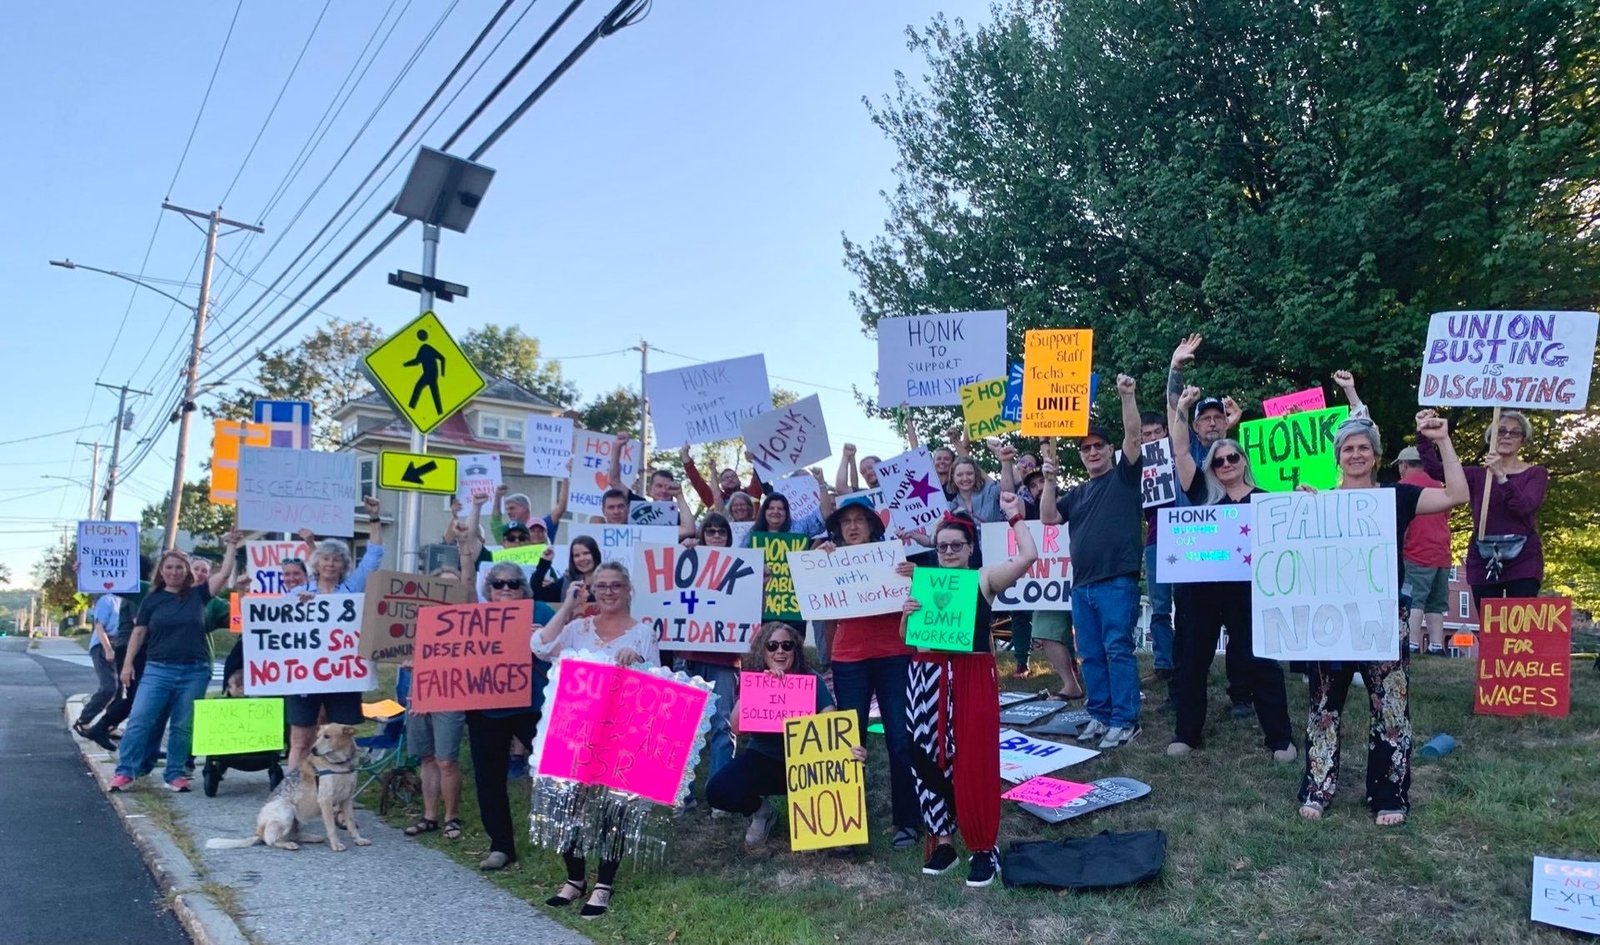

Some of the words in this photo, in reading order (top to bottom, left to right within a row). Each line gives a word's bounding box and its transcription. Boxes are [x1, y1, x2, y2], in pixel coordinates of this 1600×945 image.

[908, 318, 965, 347] HONK
[1448, 314, 1556, 341] UNION
[1029, 331, 1080, 350] Support
[929, 345, 947, 357] TO
[1428, 338, 1570, 367] BUSTING
[908, 358, 962, 373] SUPPORT
[1482, 364, 1504, 376] IS
[680, 367, 732, 391] HONK
[907, 379, 940, 398] BMH
[978, 380, 1007, 401] HO
[1036, 396, 1081, 412] UNITE
[969, 414, 1007, 438] FAIR
[1026, 412, 1045, 420] LETS
[1034, 420, 1075, 429] NEGOTIATE
[536, 422, 562, 433] BMH
[686, 414, 720, 440] BMH
[751, 409, 802, 472] HONK
[1243, 413, 1341, 466] HONK
[533, 446, 571, 458] UNITED
[586, 438, 635, 462] HOK
[584, 456, 603, 468] IF
[879, 463, 901, 477] WE
[1280, 467, 1300, 490] 4
[244, 478, 264, 495] IS
[267, 480, 331, 500] CHEAPER
[889, 469, 916, 510] WORK
[243, 499, 343, 525] TURNOVER
[789, 493, 810, 511] OUR
[793, 500, 818, 520] PPORT
[904, 502, 923, 512] FOR
[636, 507, 664, 525] ONK
[911, 507, 942, 526] YOU
[1169, 509, 1217, 524] HONK
[1256, 492, 1381, 546] FAIR
[85, 525, 127, 535] HONK
[603, 528, 642, 547] BMH
[82, 546, 130, 556] SUPPORT
[251, 543, 311, 567] UNIO
[801, 547, 896, 570] Solidarity
[94, 556, 124, 567] BMH
[644, 547, 755, 595] HONK
[1020, 557, 1072, 579] AN'T
[1255, 543, 1396, 598] CONTRACT
[92, 569, 128, 578] STAFF
[835, 570, 869, 586] with
[930, 575, 960, 591] WE
[764, 594, 800, 615] AGES
[808, 590, 849, 611] BMH
[250, 600, 330, 623] NURSES
[924, 610, 962, 628] BMH
[1483, 604, 1568, 634] HONK
[389, 623, 417, 639] OU
[436, 607, 520, 637] STAFF
[1262, 599, 1397, 655] NOW
[251, 628, 321, 650] TECHS
[908, 629, 972, 647] WORKERS
[1503, 638, 1534, 655] FOR
[422, 641, 503, 659] DESERVE
[250, 659, 280, 686] NO
[1480, 659, 1564, 679] LIVABLE
[417, 667, 466, 701] FAIR
[466, 663, 530, 695] WAGES
[744, 675, 814, 691] STRENGTH
[565, 667, 701, 724] SUPPORT
[769, 694, 786, 704] IN
[1479, 684, 1558, 707] WAGES
[200, 704, 240, 720] HONK
[248, 703, 275, 720] FOR
[742, 707, 813, 720] SOLIDARITY
[208, 721, 256, 734] LOCAL
[786, 716, 853, 758] FAIR
[199, 734, 282, 751] HEALTHCARE
[999, 736, 1063, 758] BMH
[788, 758, 863, 792] CONTRACT
[792, 786, 862, 839] NOW
